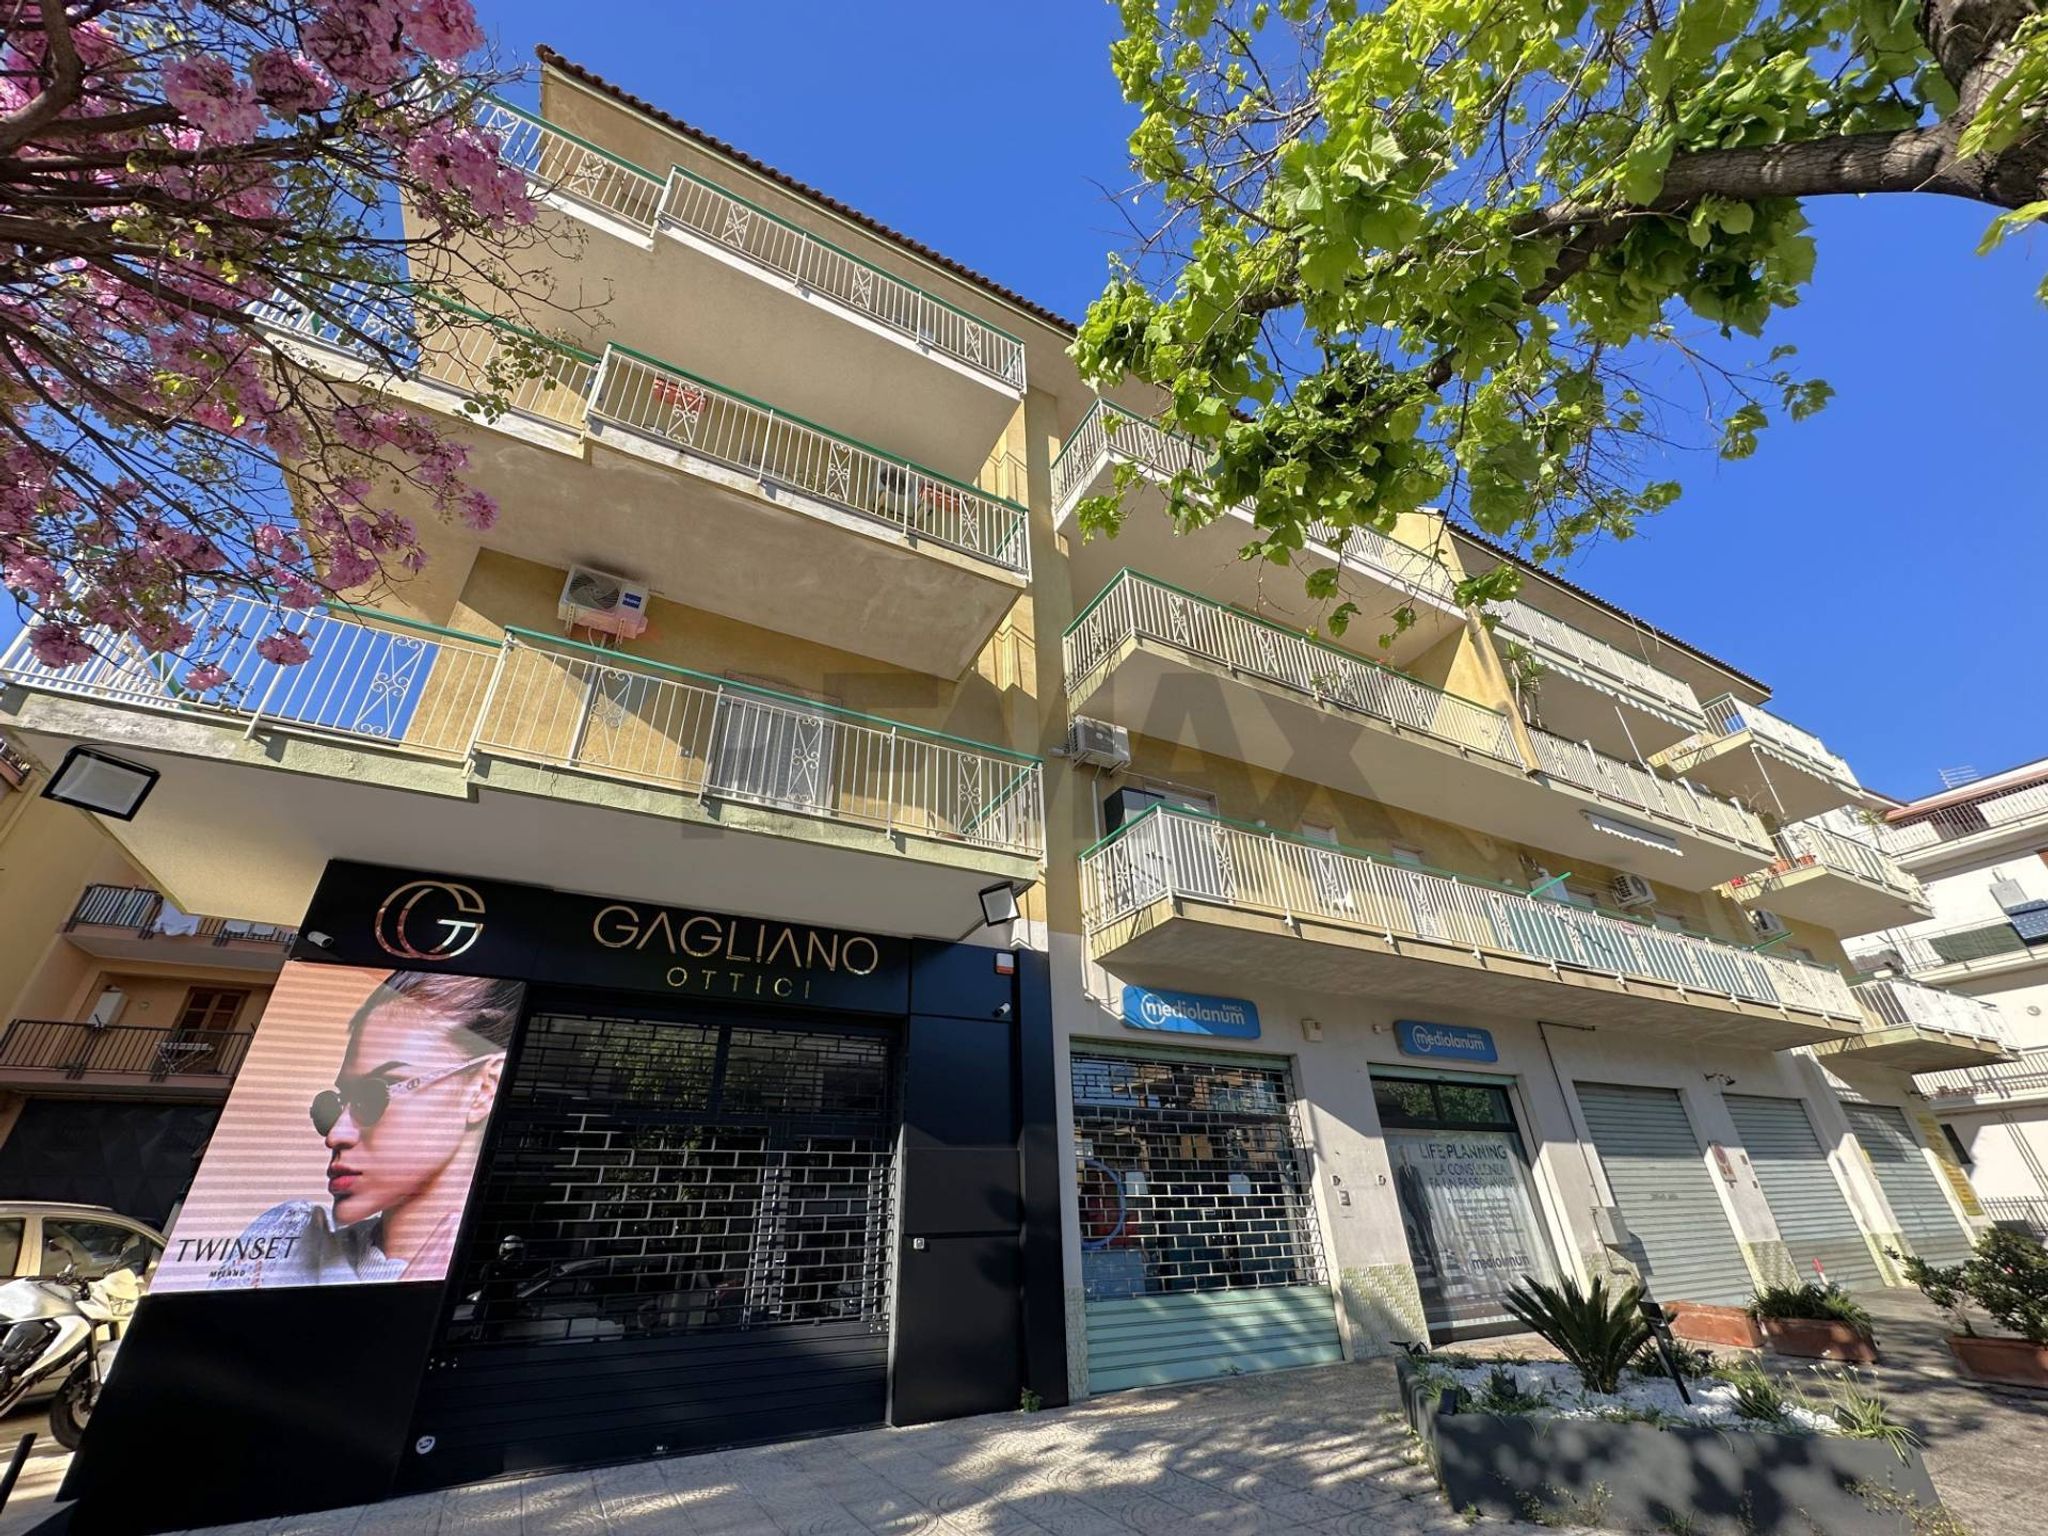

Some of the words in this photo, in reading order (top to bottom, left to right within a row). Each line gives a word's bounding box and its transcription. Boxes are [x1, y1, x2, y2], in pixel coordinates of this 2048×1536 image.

[593, 905, 878, 976] GAGLIANO
[666, 967, 810, 999] OTTICI
[1145, 999, 1246, 1025] mediolanum
[1416, 1030, 1486, 1051] mediolanum
[1447, 1144, 1507, 1159] PLANNING
[176, 1237, 301, 1262] TWINSET
